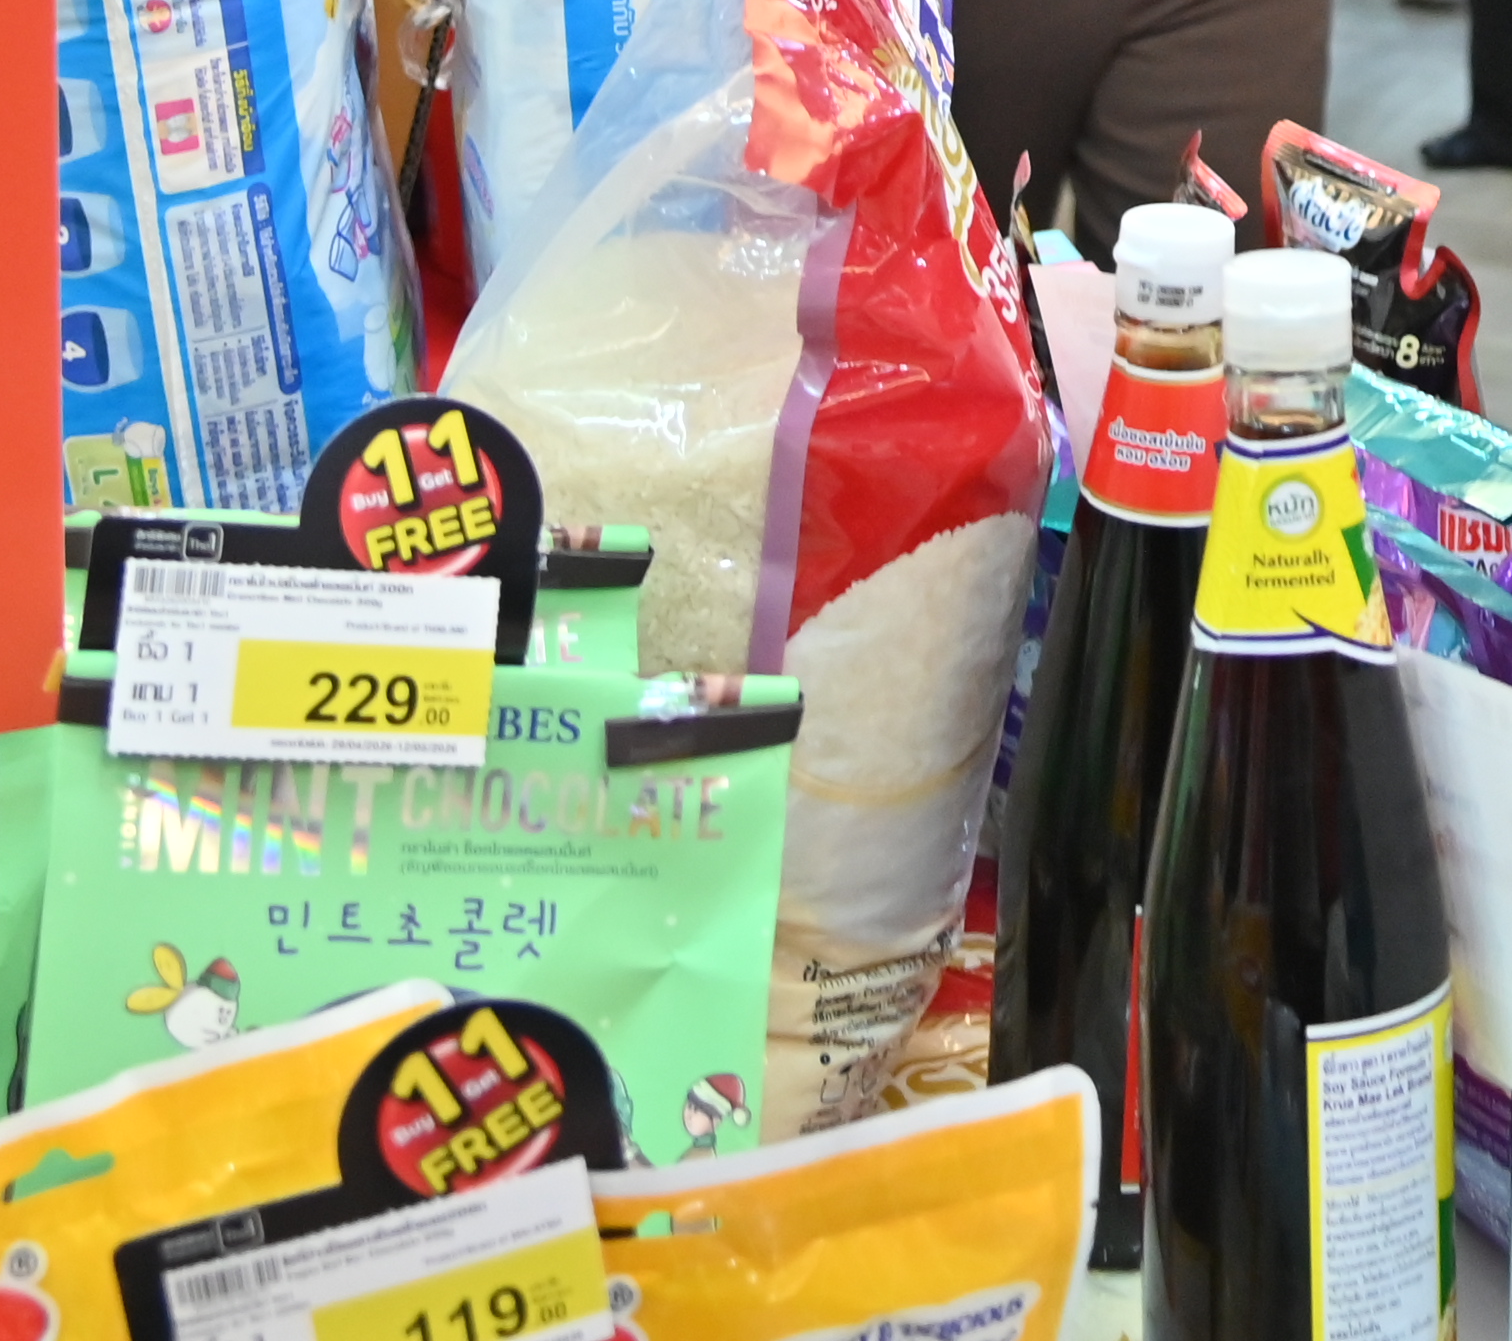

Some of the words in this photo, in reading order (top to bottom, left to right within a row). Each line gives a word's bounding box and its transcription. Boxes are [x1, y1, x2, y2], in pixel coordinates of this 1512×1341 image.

[61, 339, 86, 363] 4
[1395, 333, 1421, 370] 8
[428, 409, 481, 487] 1
[1115, 444, 1146, 467] หอม
[1148, 449, 1191, 472] อร่อย
[364, 429, 416, 507] 1
[420, 468, 453, 492] Get
[350, 488, 390, 513] Buy
[365, 496, 498, 572] FREE
[1253, 548, 1331, 570] Naturally
[1245, 570, 1336, 590] Fermented
[184, 641, 194, 662] 1
[188, 683, 199, 703] 1
[304, 670, 420, 727] 229
[138, 758, 394, 877] MINT
[400, 767, 730, 843] CHOCOLATE
[392, 1049, 463, 1126] 1
[459, 1006, 529, 1080] 1
[419, 1079, 565, 1196] FREE
